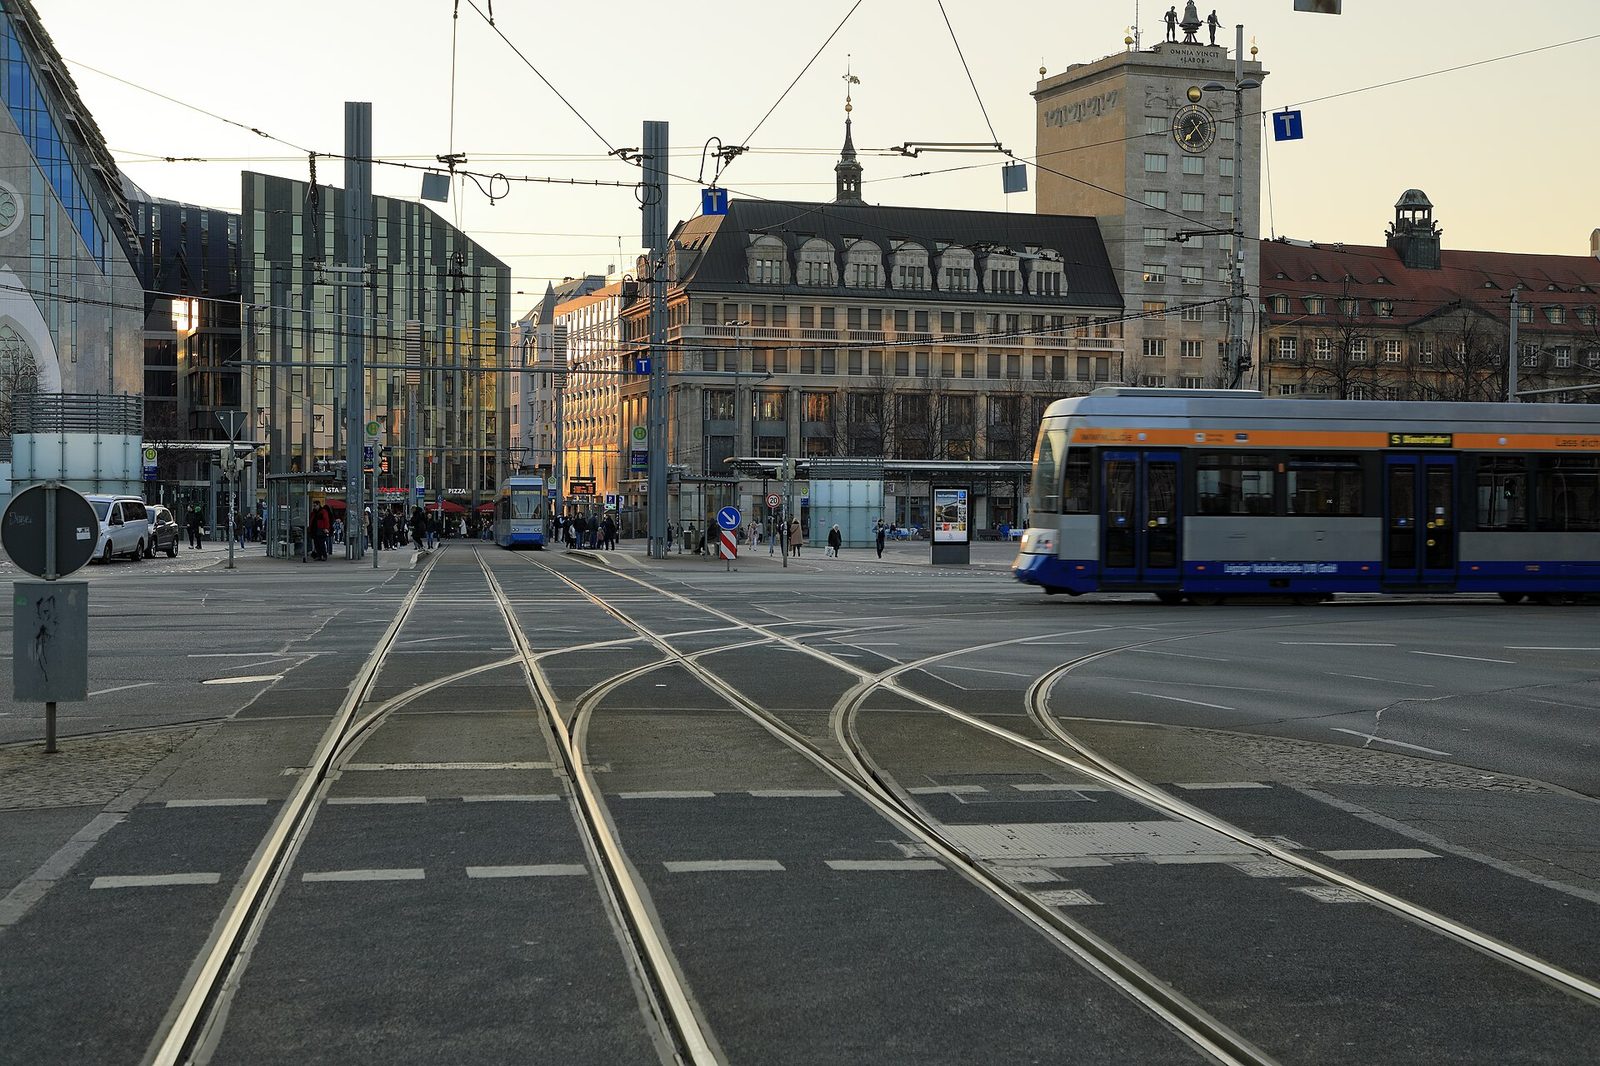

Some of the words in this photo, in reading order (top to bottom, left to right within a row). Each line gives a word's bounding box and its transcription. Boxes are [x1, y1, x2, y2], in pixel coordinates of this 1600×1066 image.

[1280, 114, 1295, 137] T
[707, 191, 722, 212] T
[639, 360, 648, 371] T
